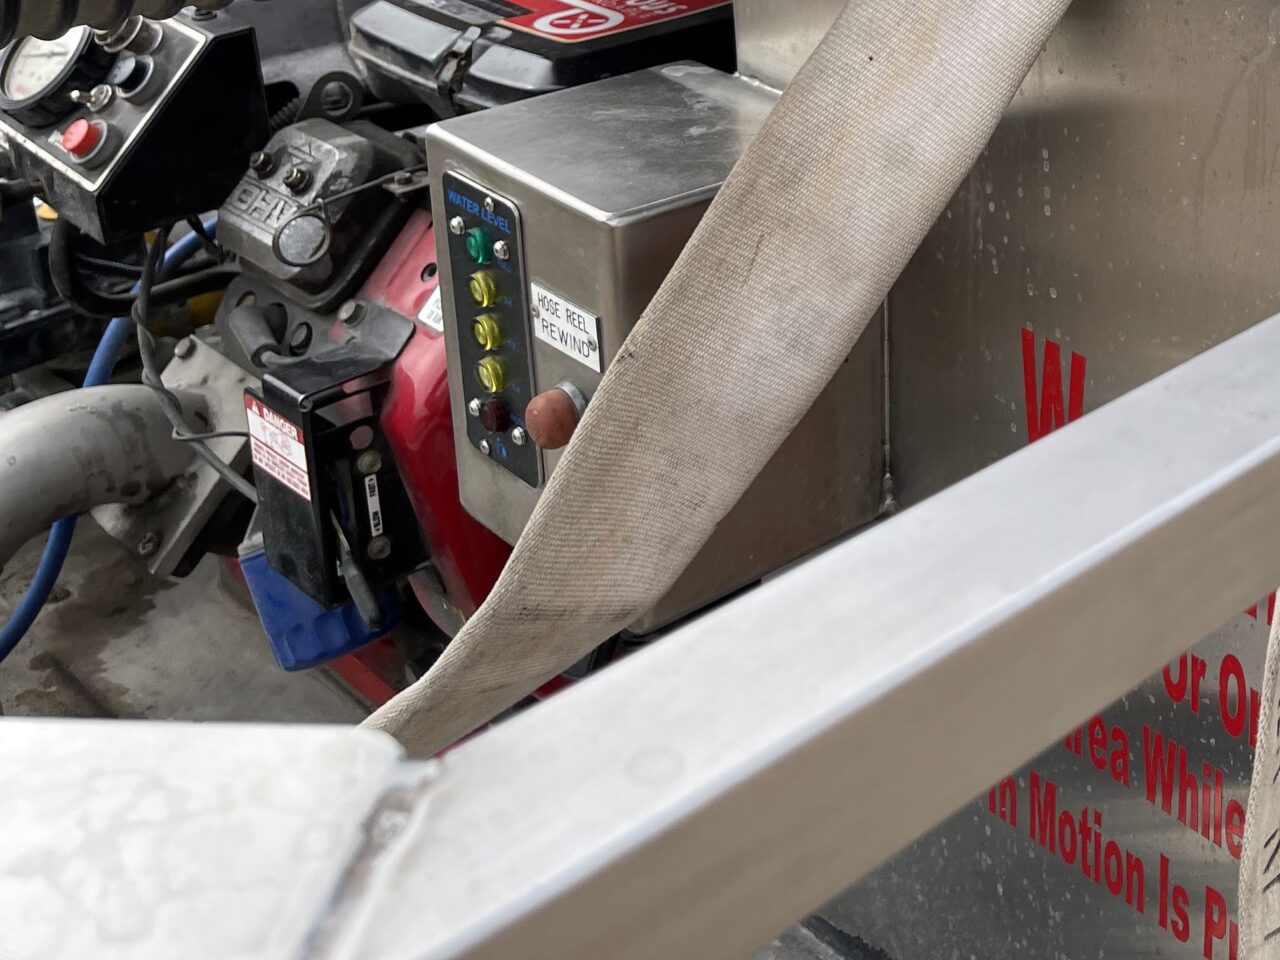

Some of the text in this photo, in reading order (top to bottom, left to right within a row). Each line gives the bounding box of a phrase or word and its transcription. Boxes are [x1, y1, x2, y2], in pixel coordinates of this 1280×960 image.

[447, 189, 511, 234] WATER LEVEL
[537, 291, 590, 335] HOSE REEL
[541, 318, 590, 358] REWIND
[263, 407, 299, 440] DANGER
[1142, 723, 1246, 860] While
[1029, 770, 1145, 914] Motion
[1158, 853, 1190, 943] Is
